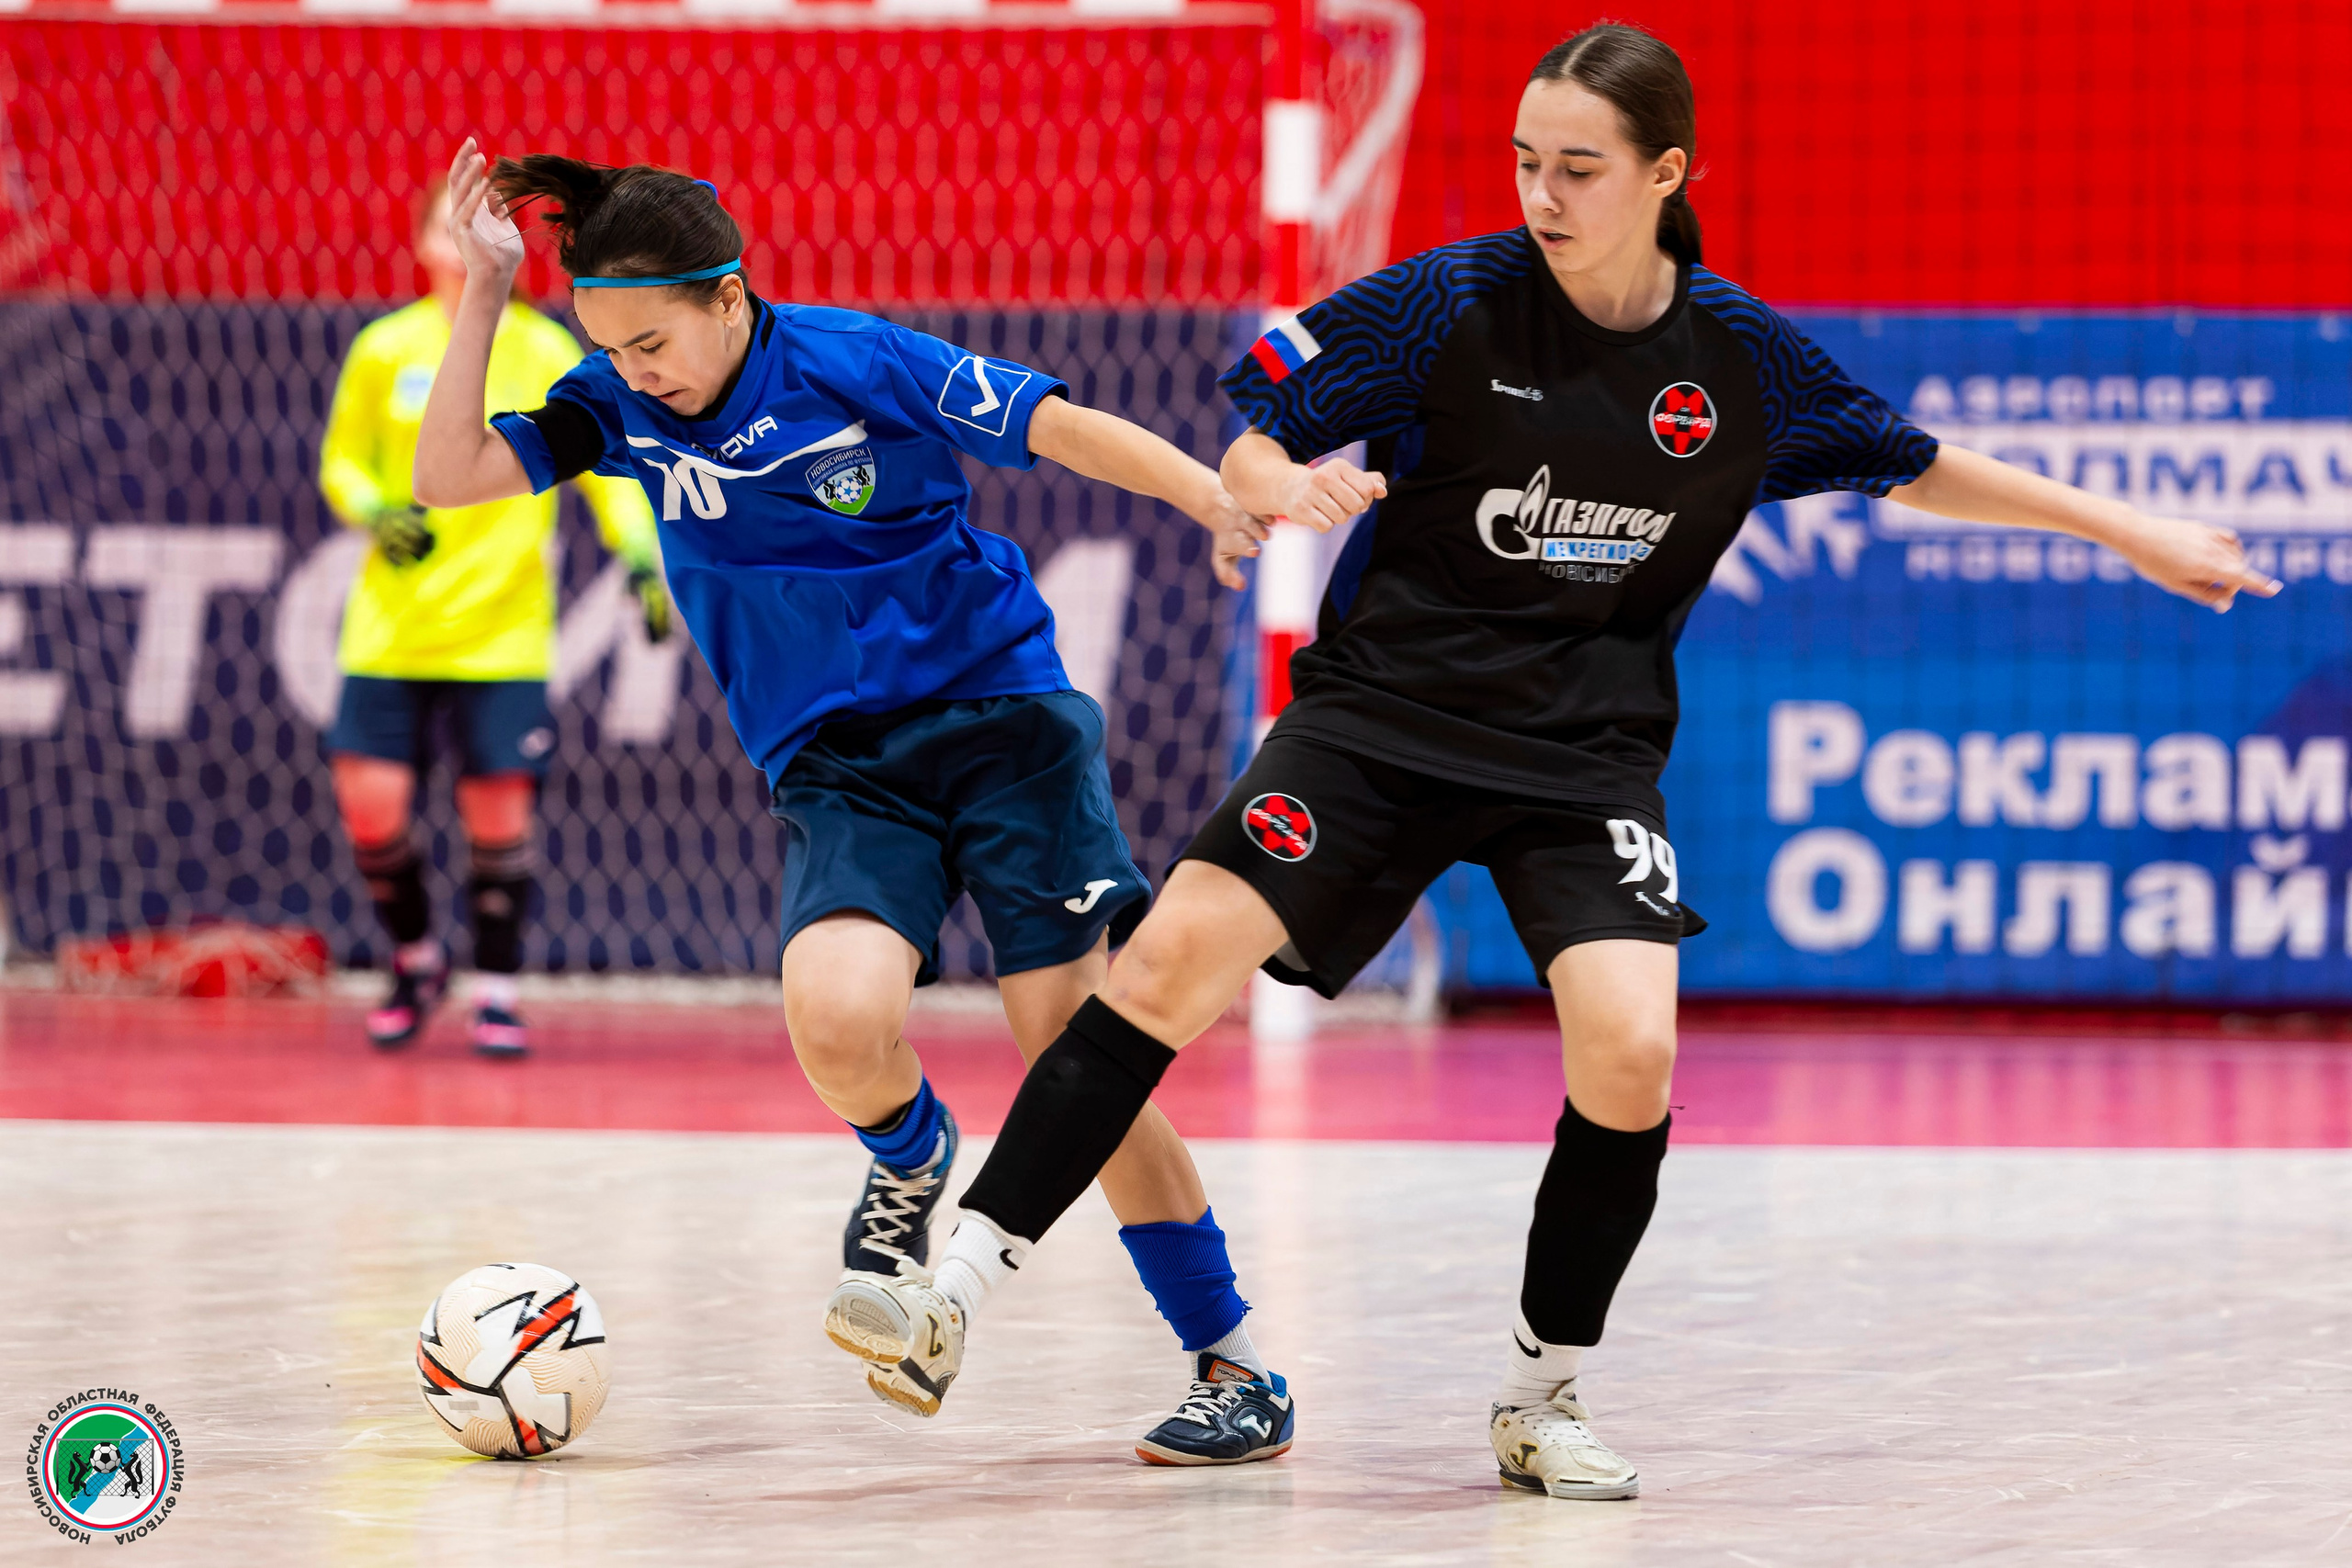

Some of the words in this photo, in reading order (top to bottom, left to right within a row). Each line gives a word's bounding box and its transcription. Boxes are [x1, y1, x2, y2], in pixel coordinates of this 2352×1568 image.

[1909, 375, 2272, 420] АЭРОПОРТ
[642, 457, 728, 522] 10
[809, 447, 866, 479] НОВОСИБИРСК
[1542, 498, 1678, 543] ГАЗПРОМ
[1765, 699, 2352, 830] Реклам
[1605, 818, 1679, 904] 99
[1765, 826, 2352, 959] Онлай
